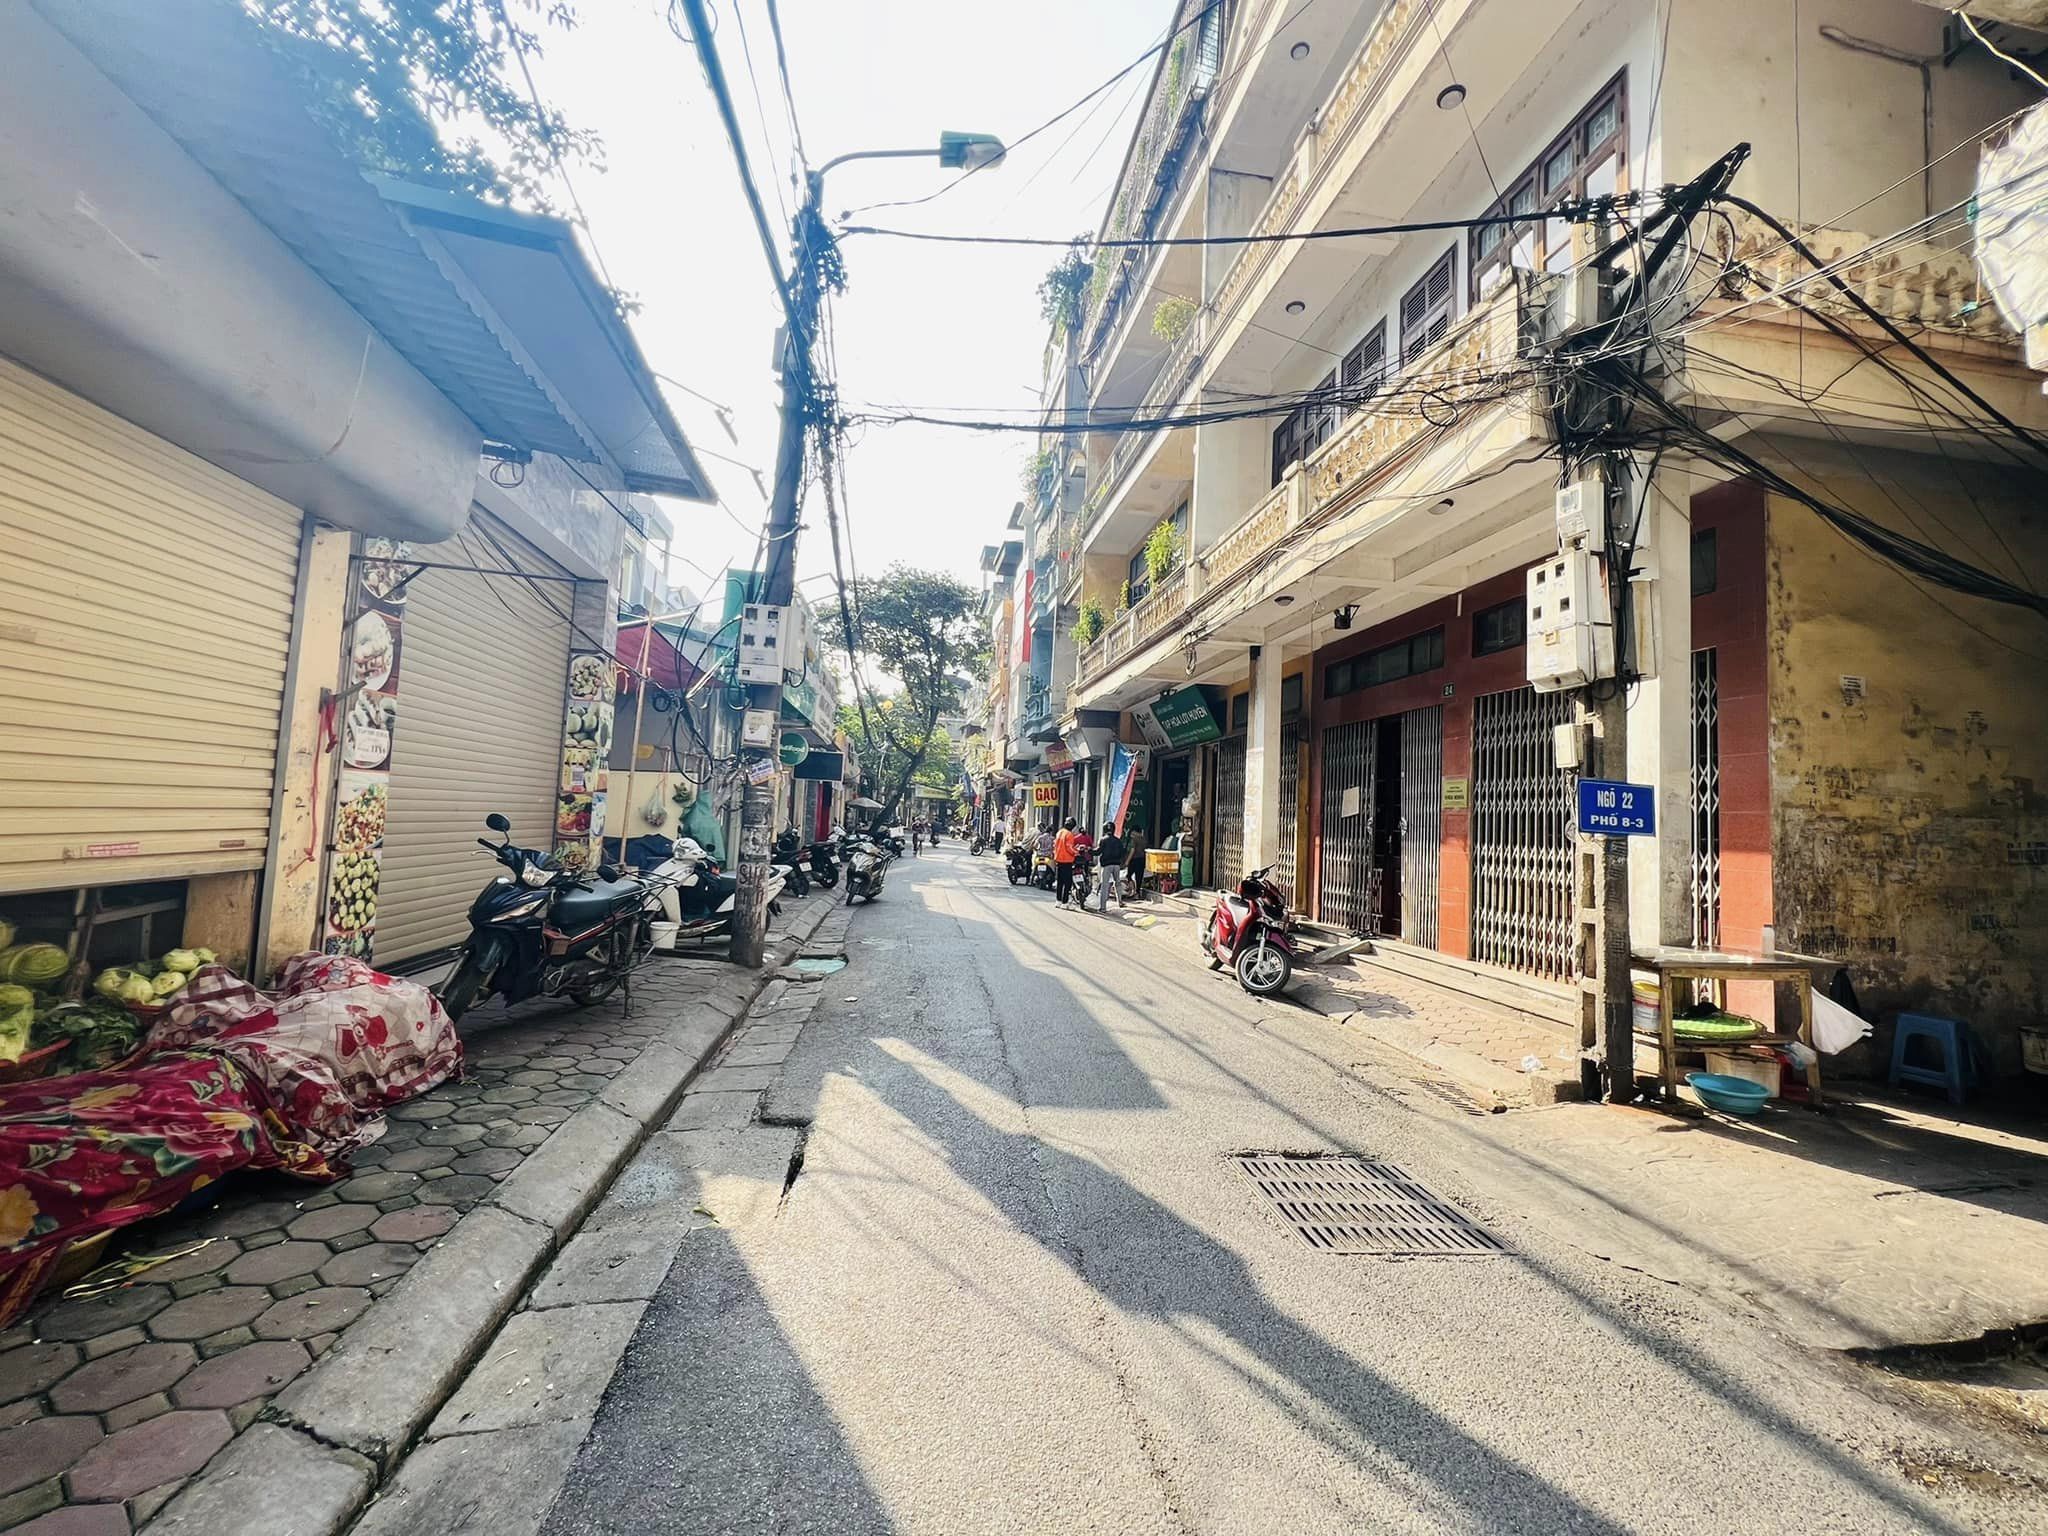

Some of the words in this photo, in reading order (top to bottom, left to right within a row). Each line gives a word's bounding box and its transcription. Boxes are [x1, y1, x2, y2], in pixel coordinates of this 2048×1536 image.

[1035, 787, 1057, 804] GẠO
[1597, 787, 1615, 808] NGÕ
[1622, 791, 1633, 809] 22
[1590, 812, 1618, 827] PHỐ
[1622, 817, 1644, 829] 8-3
